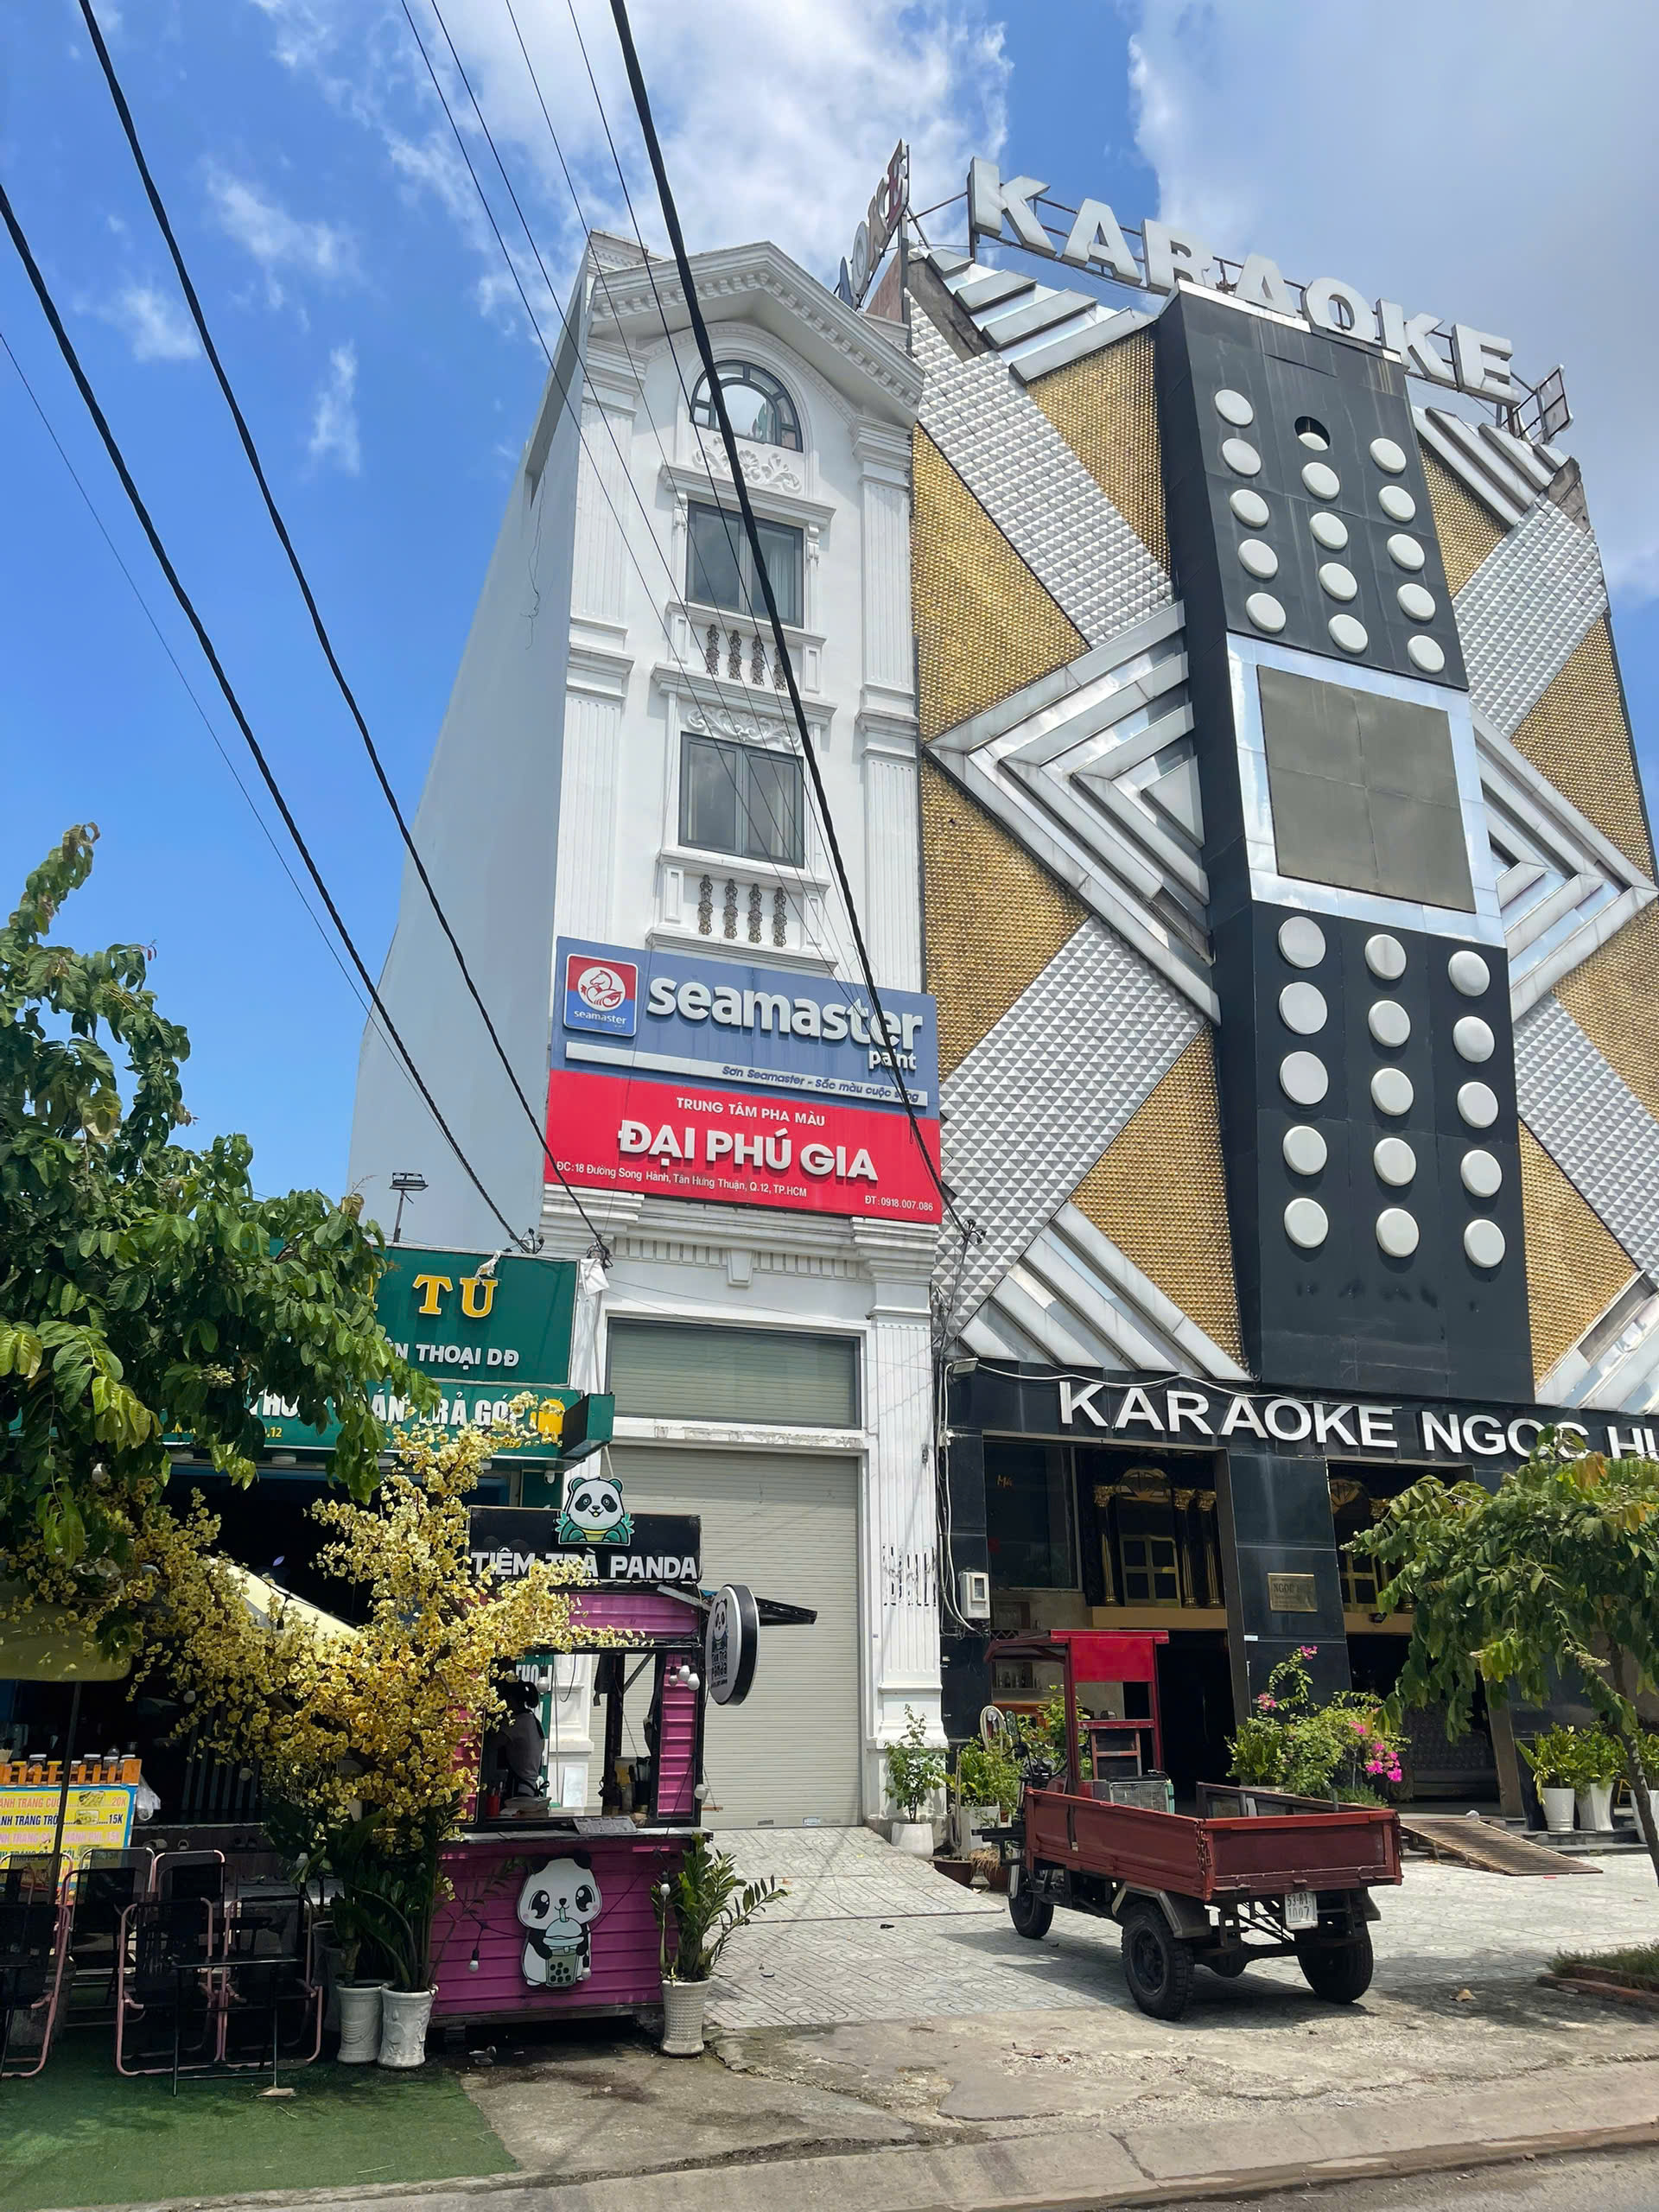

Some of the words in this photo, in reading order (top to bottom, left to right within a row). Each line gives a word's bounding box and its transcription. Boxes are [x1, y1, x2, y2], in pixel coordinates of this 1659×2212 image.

[969, 156, 1520, 408] KARAOKE
[574, 1011, 626, 1024] seamaster
[647, 976, 923, 1050] seamaster
[868, 1048, 917, 1070] pant
[722, 1066, 743, 1077] Sơn
[747, 1069, 805, 1085] Seamaster
[815, 1078, 836, 1090] Sắc
[838, 1082, 862, 1093] màu
[866, 1087, 891, 1098] cuộc
[894, 1090, 919, 1103] sng
[677, 1096, 724, 1114] TRUNG
[728, 1102, 757, 1118] TÂM
[761, 1108, 790, 1122] PHA
[795, 1110, 825, 1127] MÀU
[617, 1120, 695, 1166] ĐẠI
[706, 1128, 791, 1170] PHÚ
[800, 1143, 879, 1181] GIA
[587, 1164, 616, 1179] Đường
[619, 1167, 642, 1181] Song
[645, 1170, 671, 1184] Hành,
[673, 1173, 690, 1185] Tân
[692, 1175, 715, 1189] Hưng
[718, 1178, 747, 1191] Thuận,
[773, 1184, 806, 1197] TP.HCM
[416, 1344, 481, 1370] THOẠI
[486, 1349, 519, 1367] DĐ
[353, 1389, 405, 1422] ÁN
[1059, 1381, 1398, 1448] KARAOKE
[470, 1547, 536, 1580] TIỆM
[610, 1555, 698, 1580] PANDA
[109, 1815, 124, 1824] 15K
